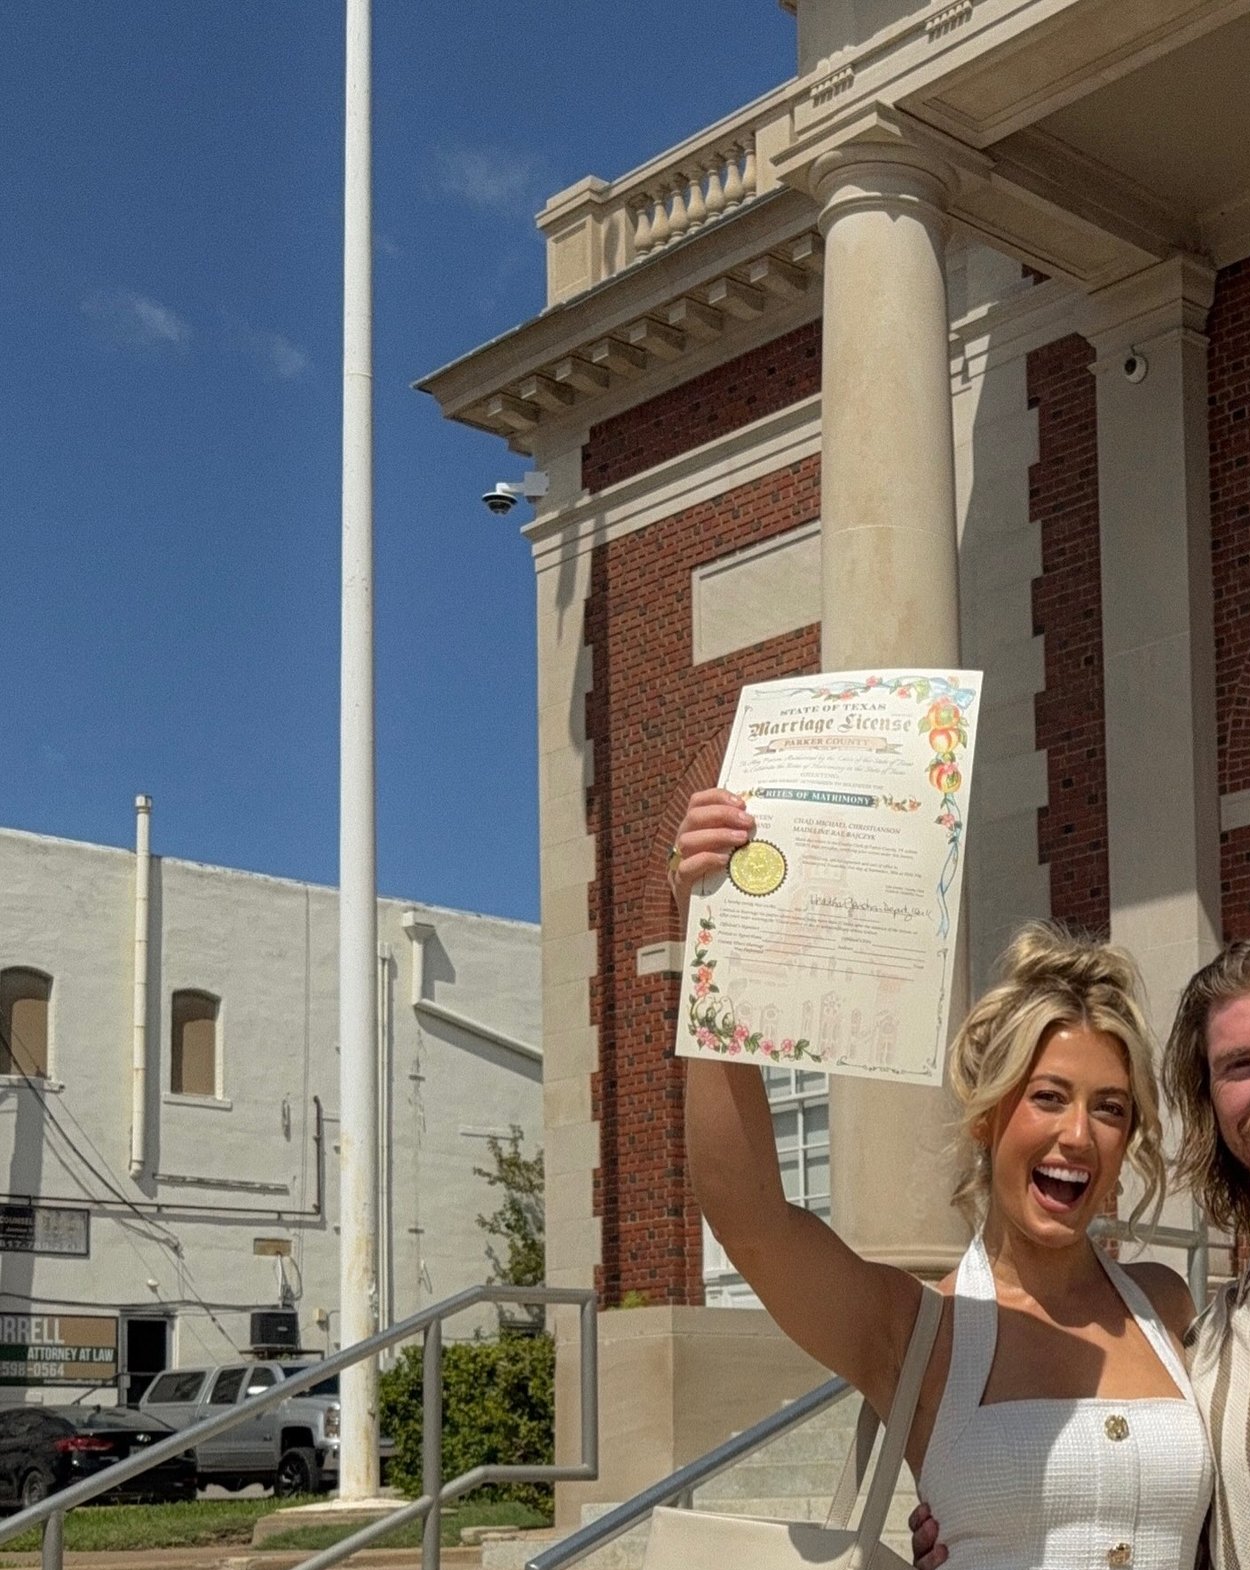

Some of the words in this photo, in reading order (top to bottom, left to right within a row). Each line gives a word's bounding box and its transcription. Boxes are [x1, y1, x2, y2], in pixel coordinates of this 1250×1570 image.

[780, 706, 819, 716] STATE
[822, 704, 839, 712] OF
[843, 703, 887, 711] TEXAS
[748, 716, 834, 742] Marriage
[837, 713, 912, 734] License
[784, 738, 823, 747] PARKER
[825, 738, 870, 746] COUNTY
[766, 789, 793, 798] RITES
[796, 791, 809, 799] OF
[812, 792, 870, 805] MATRIMONY
[793, 817, 815, 825] CHAD
[816, 819, 847, 829] MICHAEL
[848, 823, 901, 835] CHRISTIANSON
[0, 1316, 65, 1344] RRELL
[27, 1346, 77, 1360] ATTORNEY
[79, 1348, 91, 1361] AT
[92, 1348, 114, 1361] LAW
[0, 1361, 65, 1377] 598-0564
